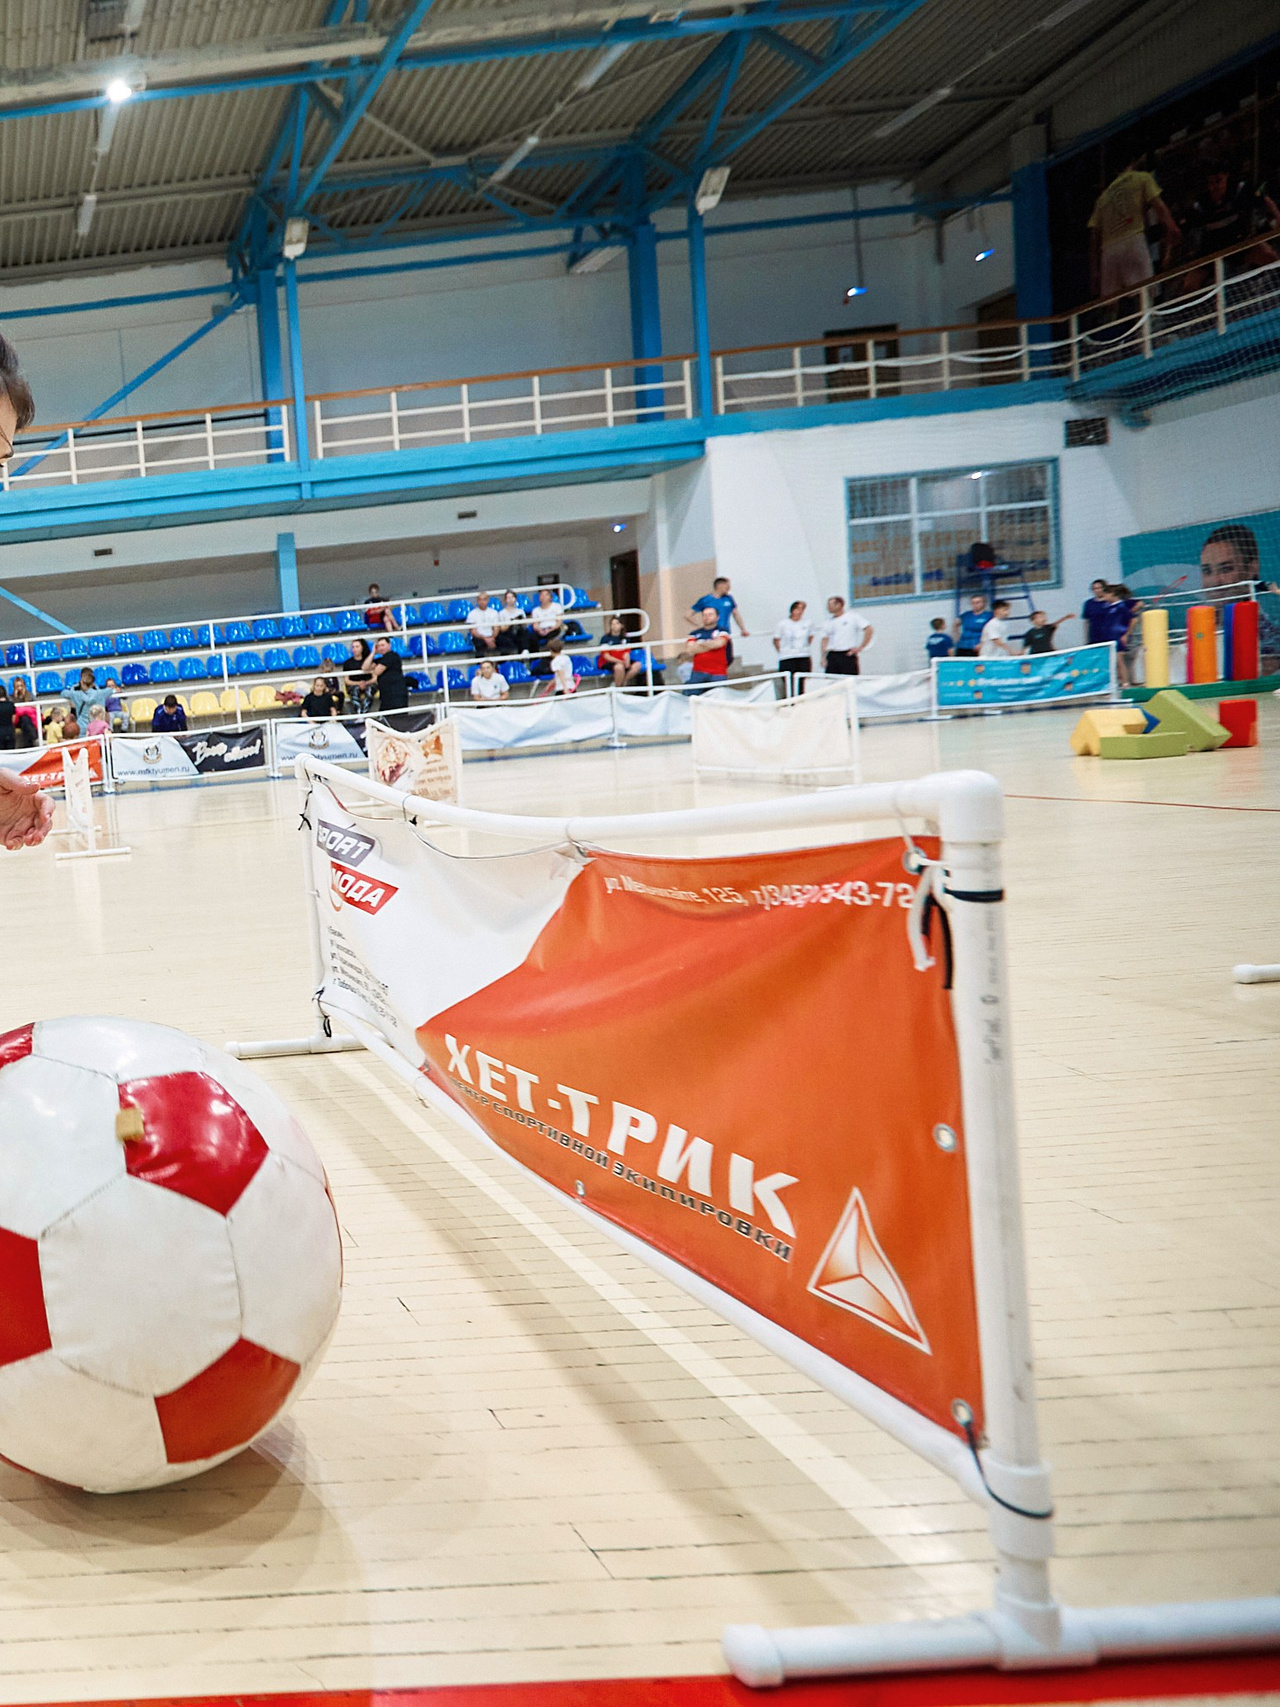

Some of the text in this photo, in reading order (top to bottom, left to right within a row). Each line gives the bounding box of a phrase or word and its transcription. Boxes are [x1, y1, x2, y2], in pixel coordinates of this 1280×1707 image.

[445, 1033, 800, 1239] ХЕТ-ТРИК
[492, 1102, 609, 1170] СПОРТИВНОЙ
[612, 1161, 794, 1264] ЭКИПИРОВКИ
